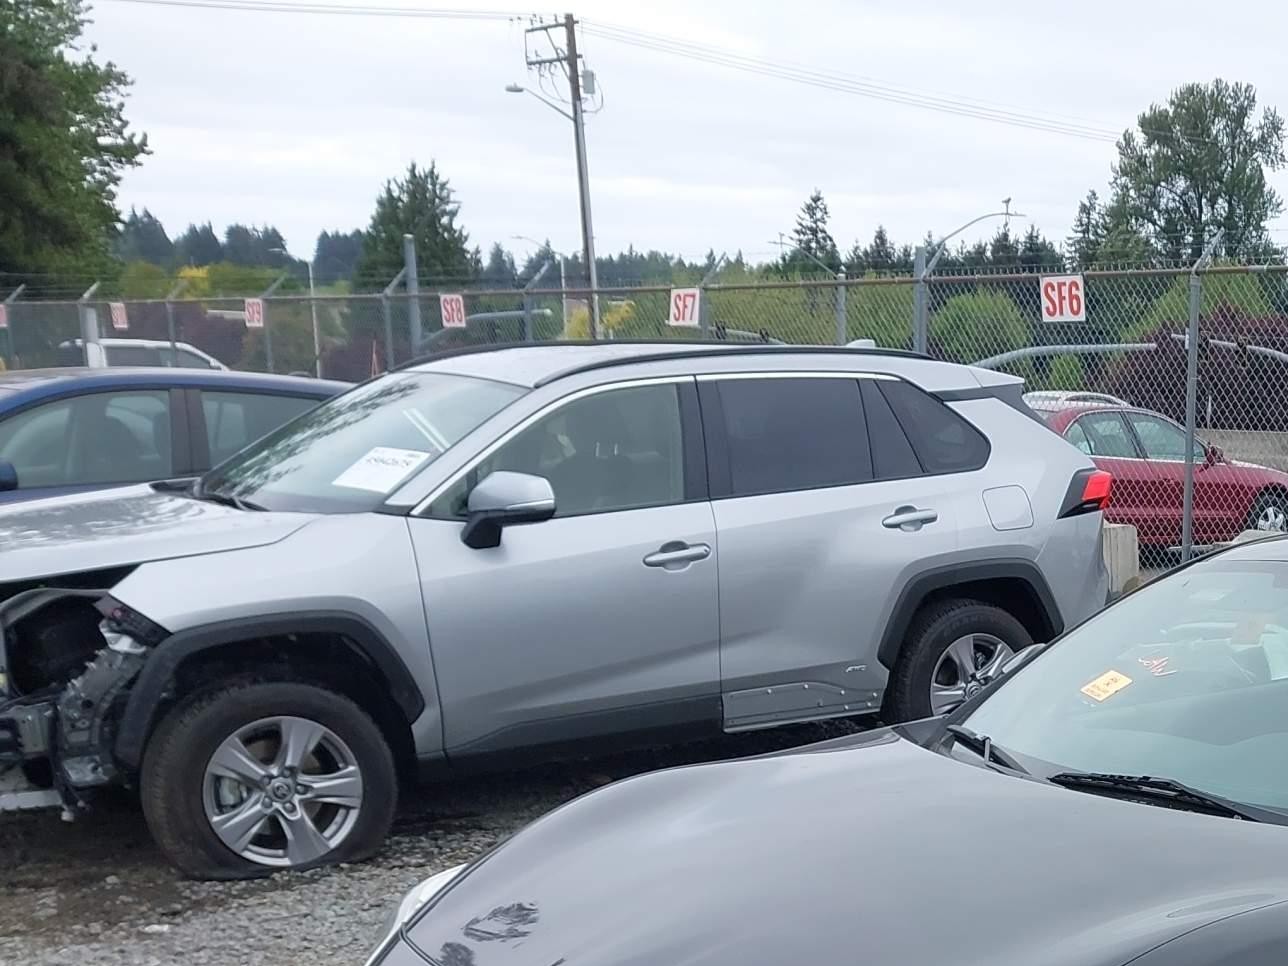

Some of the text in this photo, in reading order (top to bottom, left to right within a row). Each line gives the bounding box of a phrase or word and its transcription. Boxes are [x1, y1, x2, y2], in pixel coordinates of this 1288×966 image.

[442, 297, 463, 323] SF8
[673, 293, 697, 322] SF7
[1043, 280, 1082, 317] SF6
